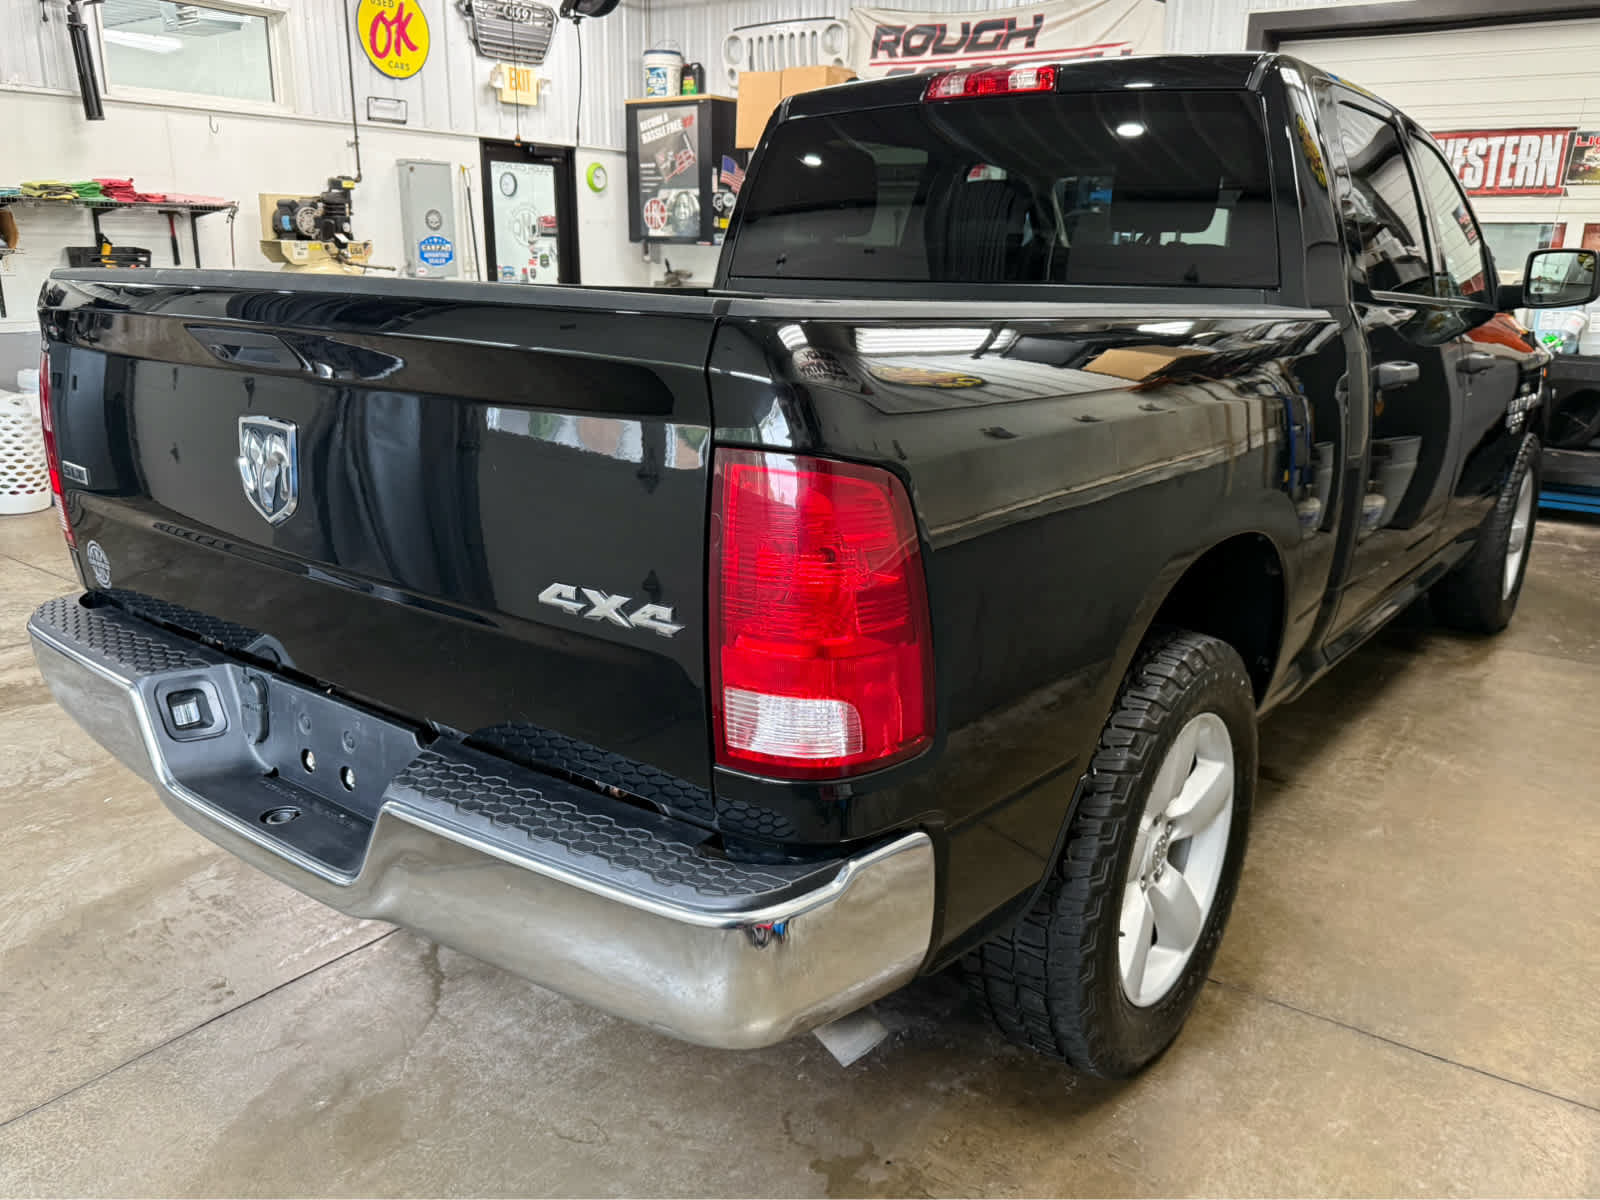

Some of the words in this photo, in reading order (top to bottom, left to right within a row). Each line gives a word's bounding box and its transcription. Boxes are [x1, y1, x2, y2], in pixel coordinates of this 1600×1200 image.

[369, 2, 419, 59] OK
[870, 14, 1044, 59] ROUGH
[388, 60, 411, 71] CARS
[508, 66, 531, 93] EXIT
